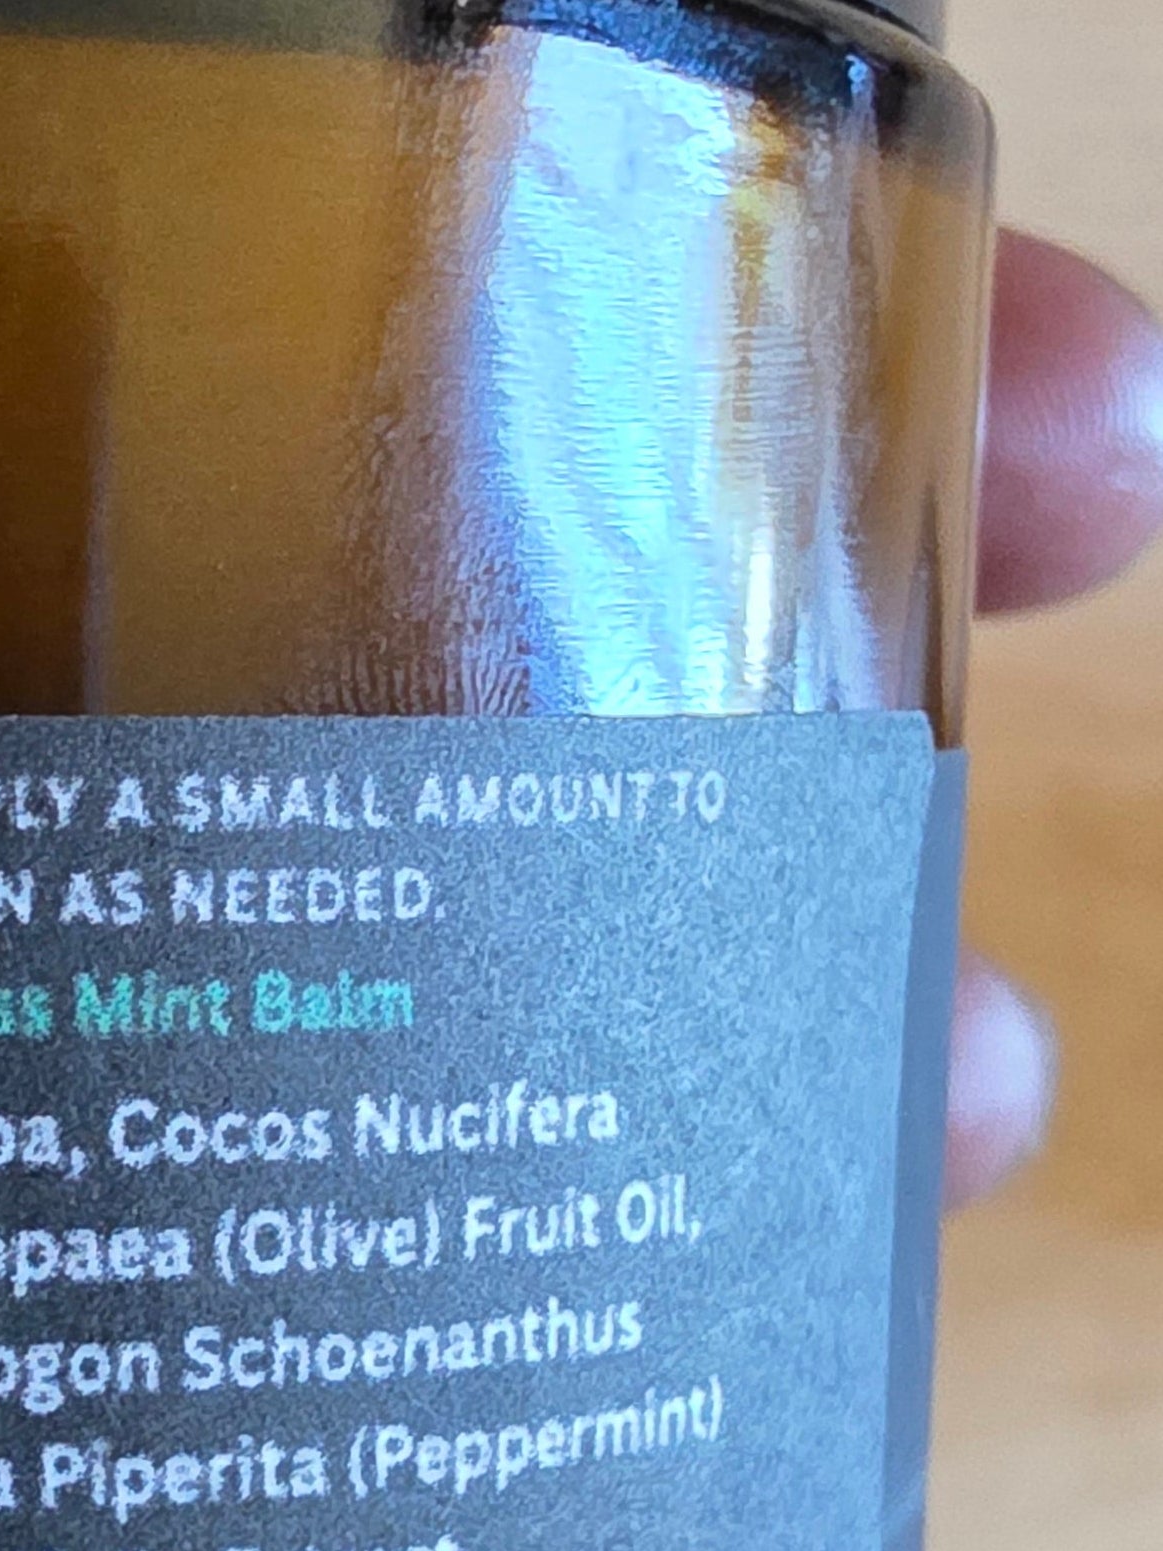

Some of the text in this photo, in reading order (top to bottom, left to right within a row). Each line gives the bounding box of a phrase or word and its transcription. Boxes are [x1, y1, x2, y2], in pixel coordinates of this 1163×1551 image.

[104, 775, 151, 829] A
[170, 771, 392, 833] SMALL
[416, 772, 648, 828] AMOUNT
[665, 769, 726, 823] TO
[58, 867, 145, 926] AS
[170, 865, 447, 926] NEEDED.
[72, 969, 234, 1040] Mint
[250, 969, 415, 1038] Balm
[108, 1094, 334, 1169] Cocos
[352, 1078, 621, 1158] Nucifera
[215, 1202, 440, 1285] (Olive)
[463, 1193, 599, 1260] Fruit
[615, 1176, 702, 1243] Oil,
[183, 1296, 642, 1391] Schoenanthus
[38, 1435, 328, 1524] Piperita
[347, 1376, 723, 1496] (Peppermint)
